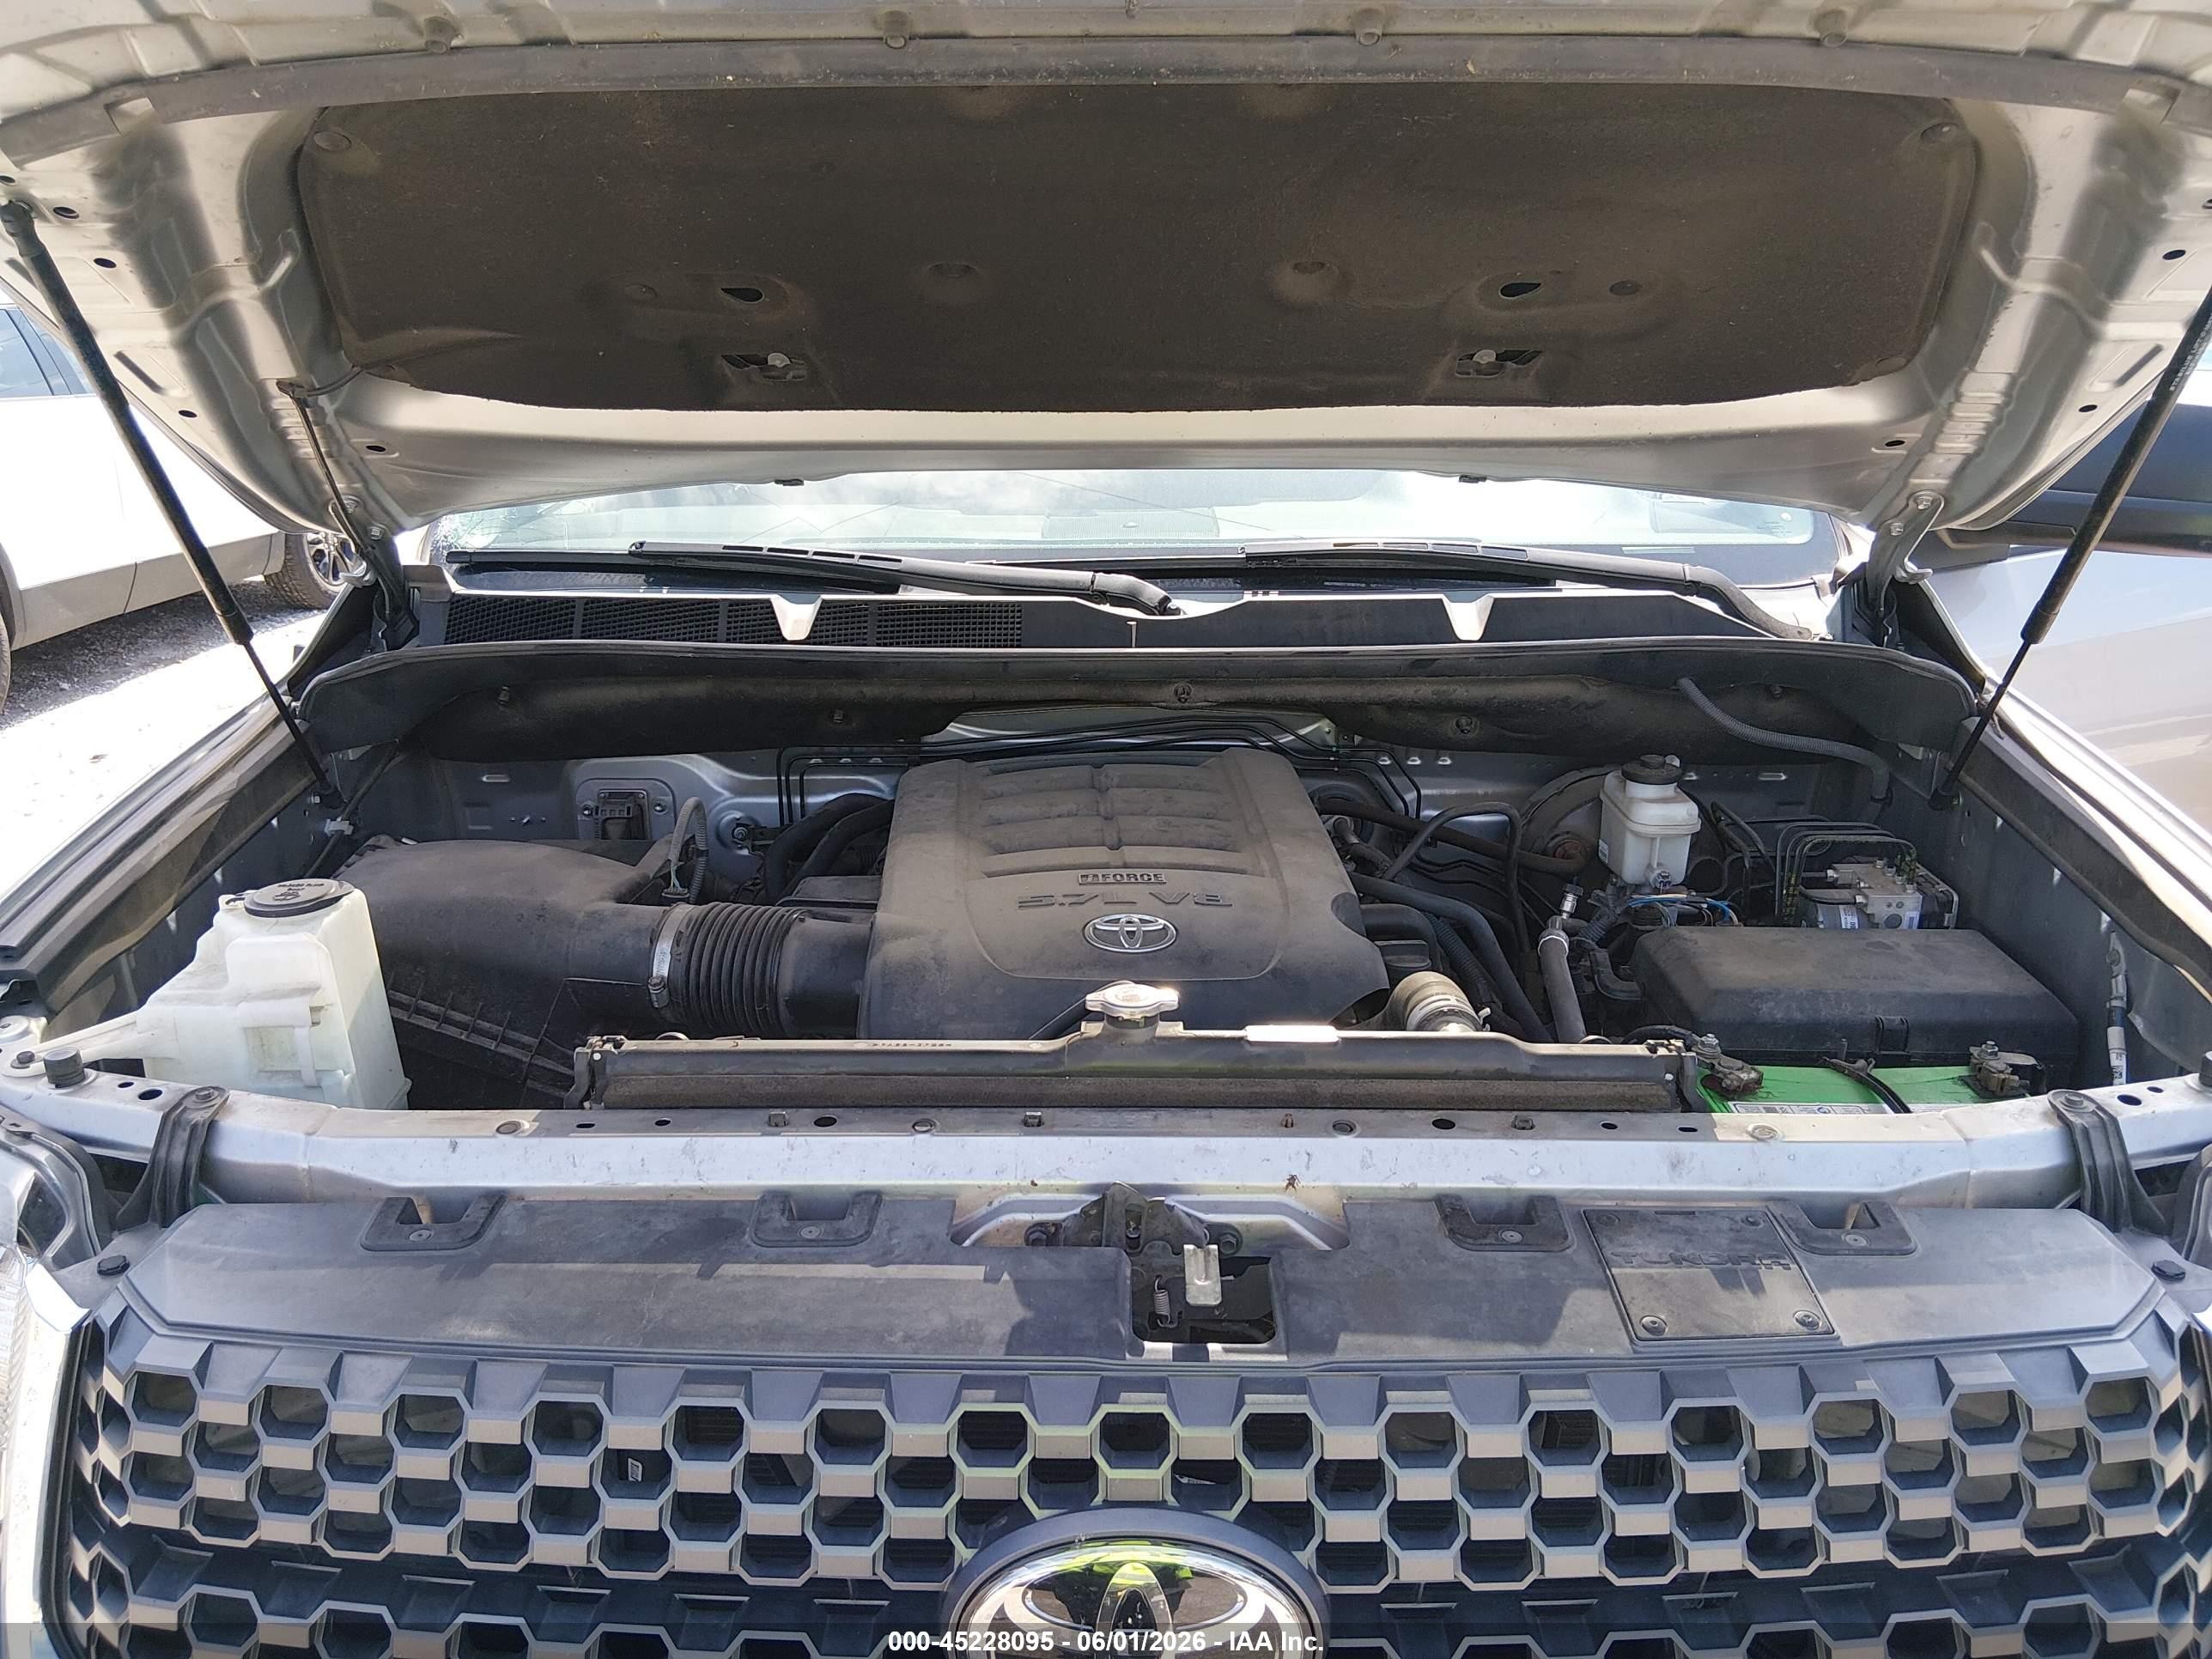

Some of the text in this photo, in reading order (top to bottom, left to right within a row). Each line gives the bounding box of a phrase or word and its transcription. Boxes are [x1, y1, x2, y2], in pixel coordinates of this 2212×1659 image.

[1018, 892, 1233, 908] 5.7L V8
[1611, 1251, 1792, 1271] TUNDRA
